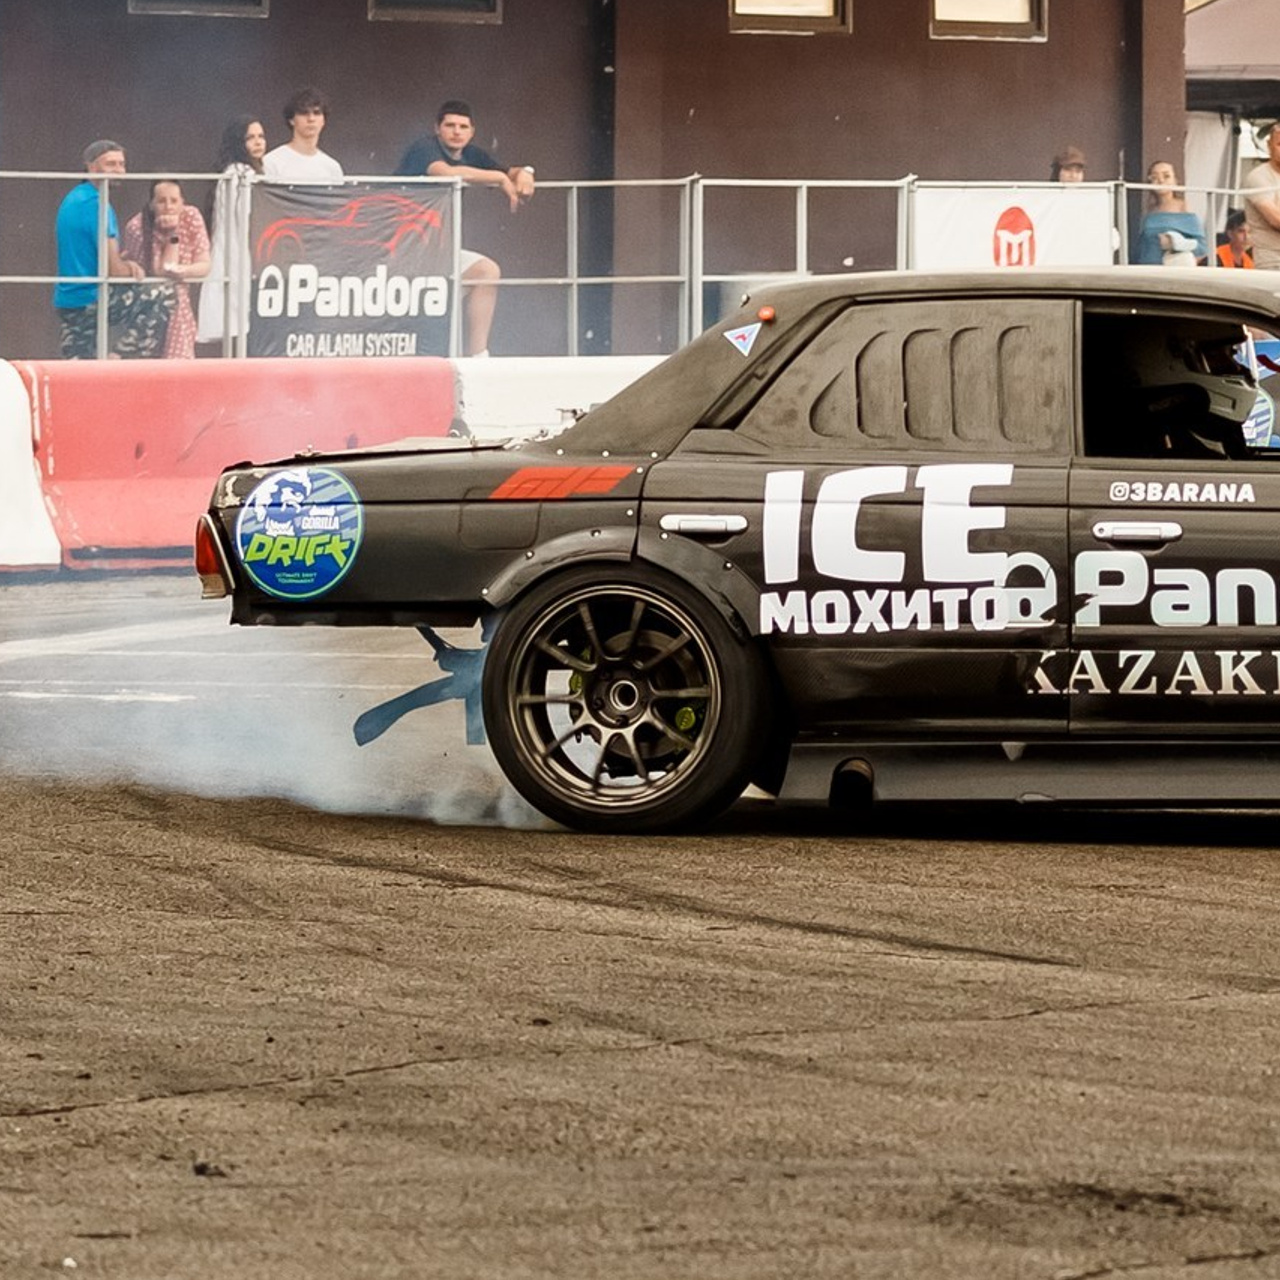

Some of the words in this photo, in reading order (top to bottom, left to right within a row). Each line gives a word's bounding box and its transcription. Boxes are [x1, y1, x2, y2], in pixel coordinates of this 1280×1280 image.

[287, 264, 448, 318] Pandora
[286, 333, 315, 357] CAR
[316, 333, 364, 357] ALARM
[365, 332, 418, 356] SYSTEM
[301, 516, 340, 530] GORILLA
[763, 463, 1014, 587] ICE
[244, 532, 351, 568] DRIFT
